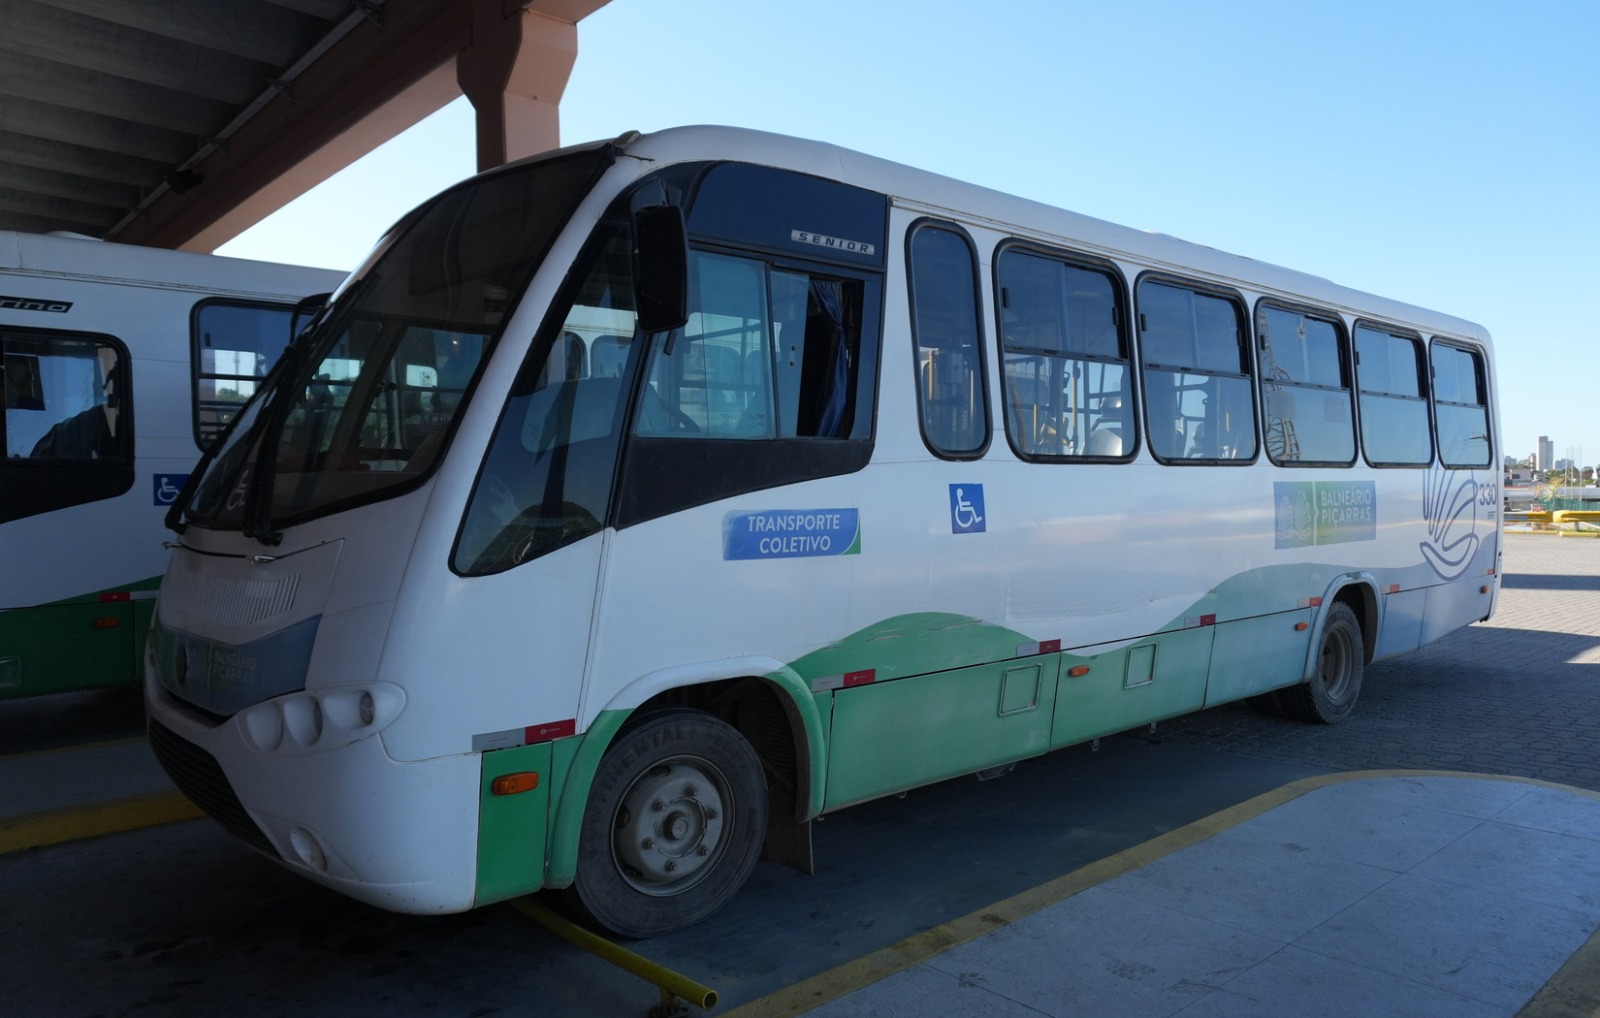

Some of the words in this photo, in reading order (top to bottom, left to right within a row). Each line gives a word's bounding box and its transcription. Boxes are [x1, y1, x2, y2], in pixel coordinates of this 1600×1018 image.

[798, 232, 870, 254] SENIOR
[1321, 486, 1371, 506] BALNEÁRIO
[1479, 482, 1498, 506] 330
[747, 514, 841, 532] TRANSPORTE
[1321, 507, 1371, 527] PIÇARRAS
[759, 535, 831, 554] COLETIVO
